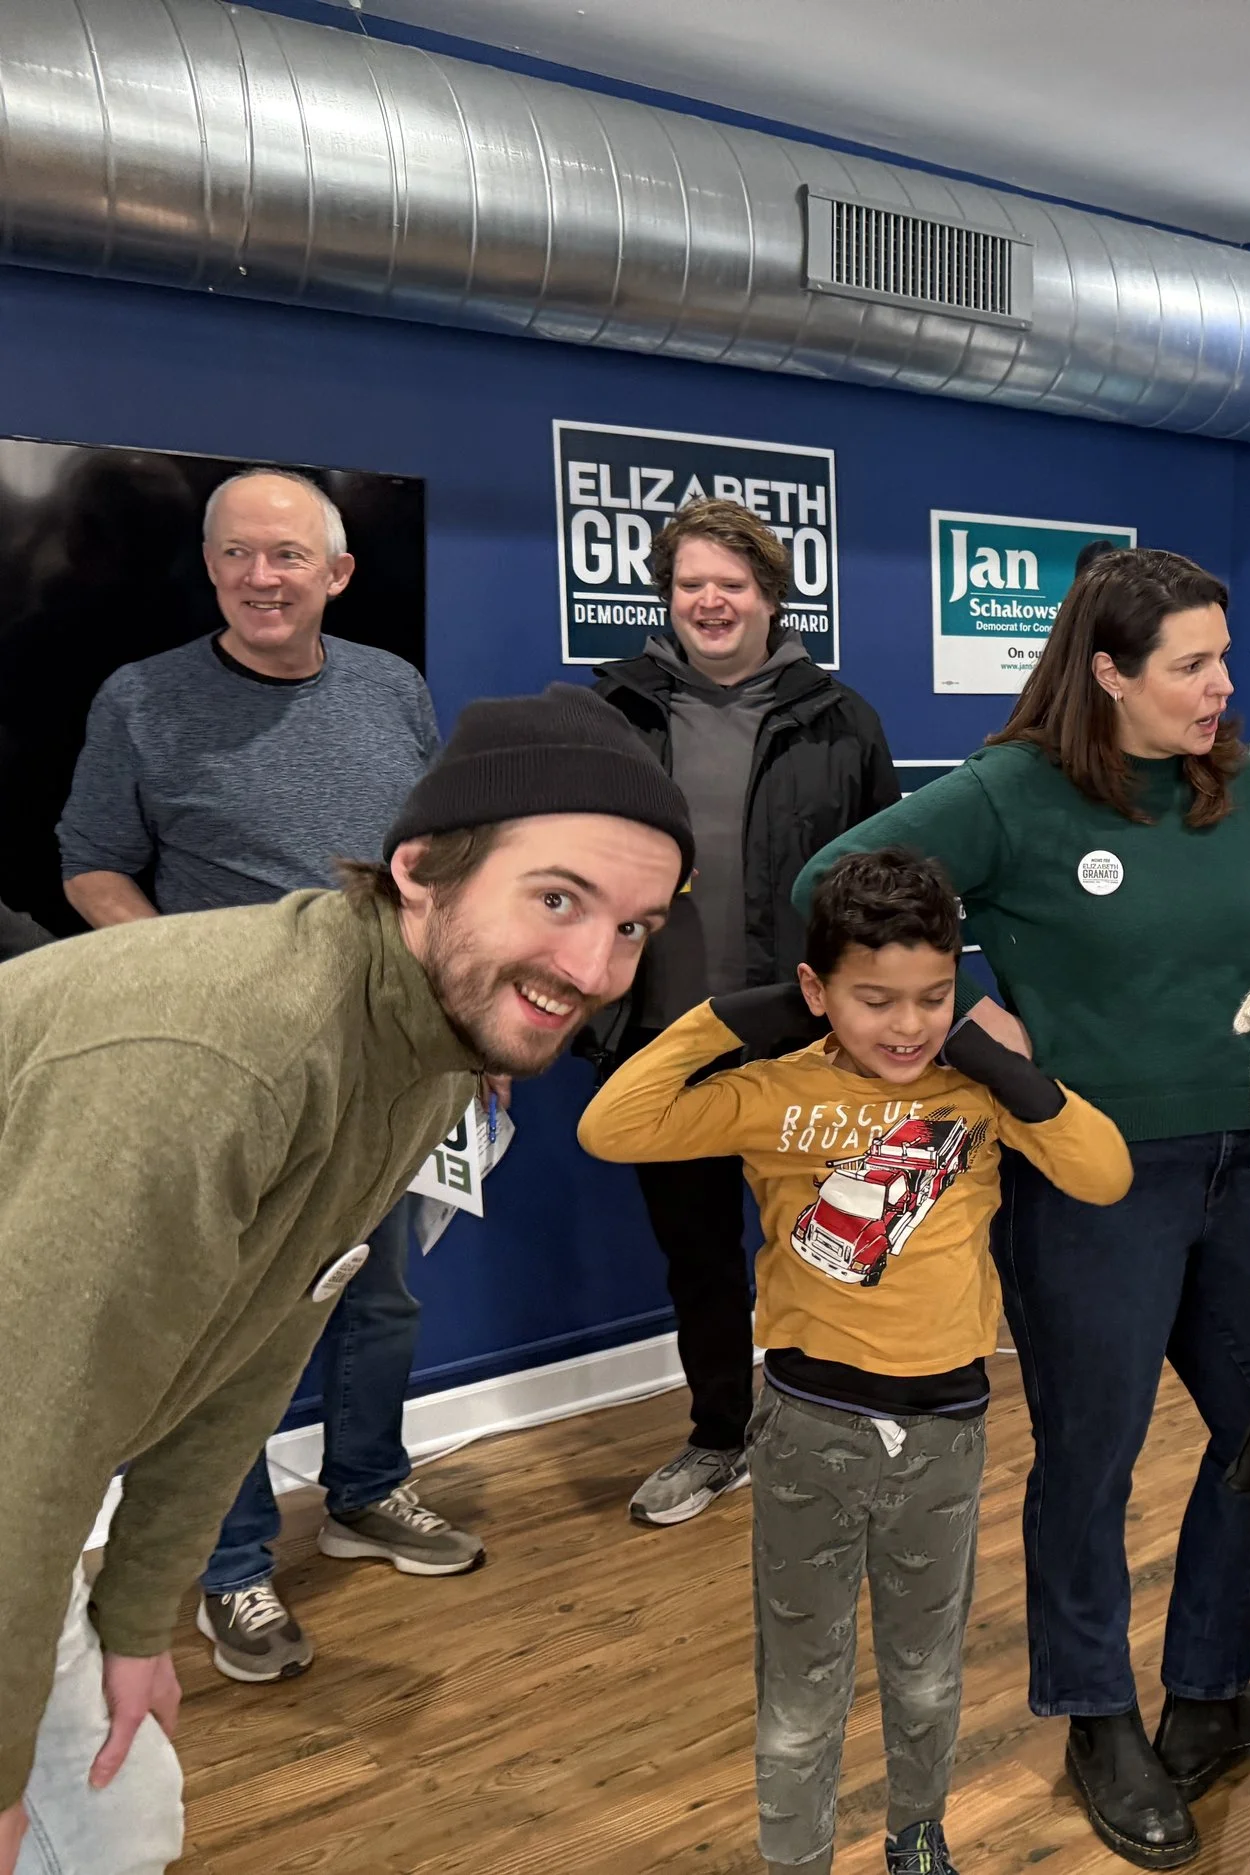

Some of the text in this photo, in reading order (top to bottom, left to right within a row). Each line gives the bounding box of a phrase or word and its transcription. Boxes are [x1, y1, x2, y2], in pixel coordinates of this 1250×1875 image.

[949, 529, 1040, 603] Jan
[574, 603, 668, 627] DEMOCRAT
[970, 598, 1063, 620] Schakows
[976, 621, 1018, 632] Democrat
[1019, 622, 1031, 632] for
[1008, 647, 1024, 659] On
[1083, 870, 1119, 879] GRANATO
